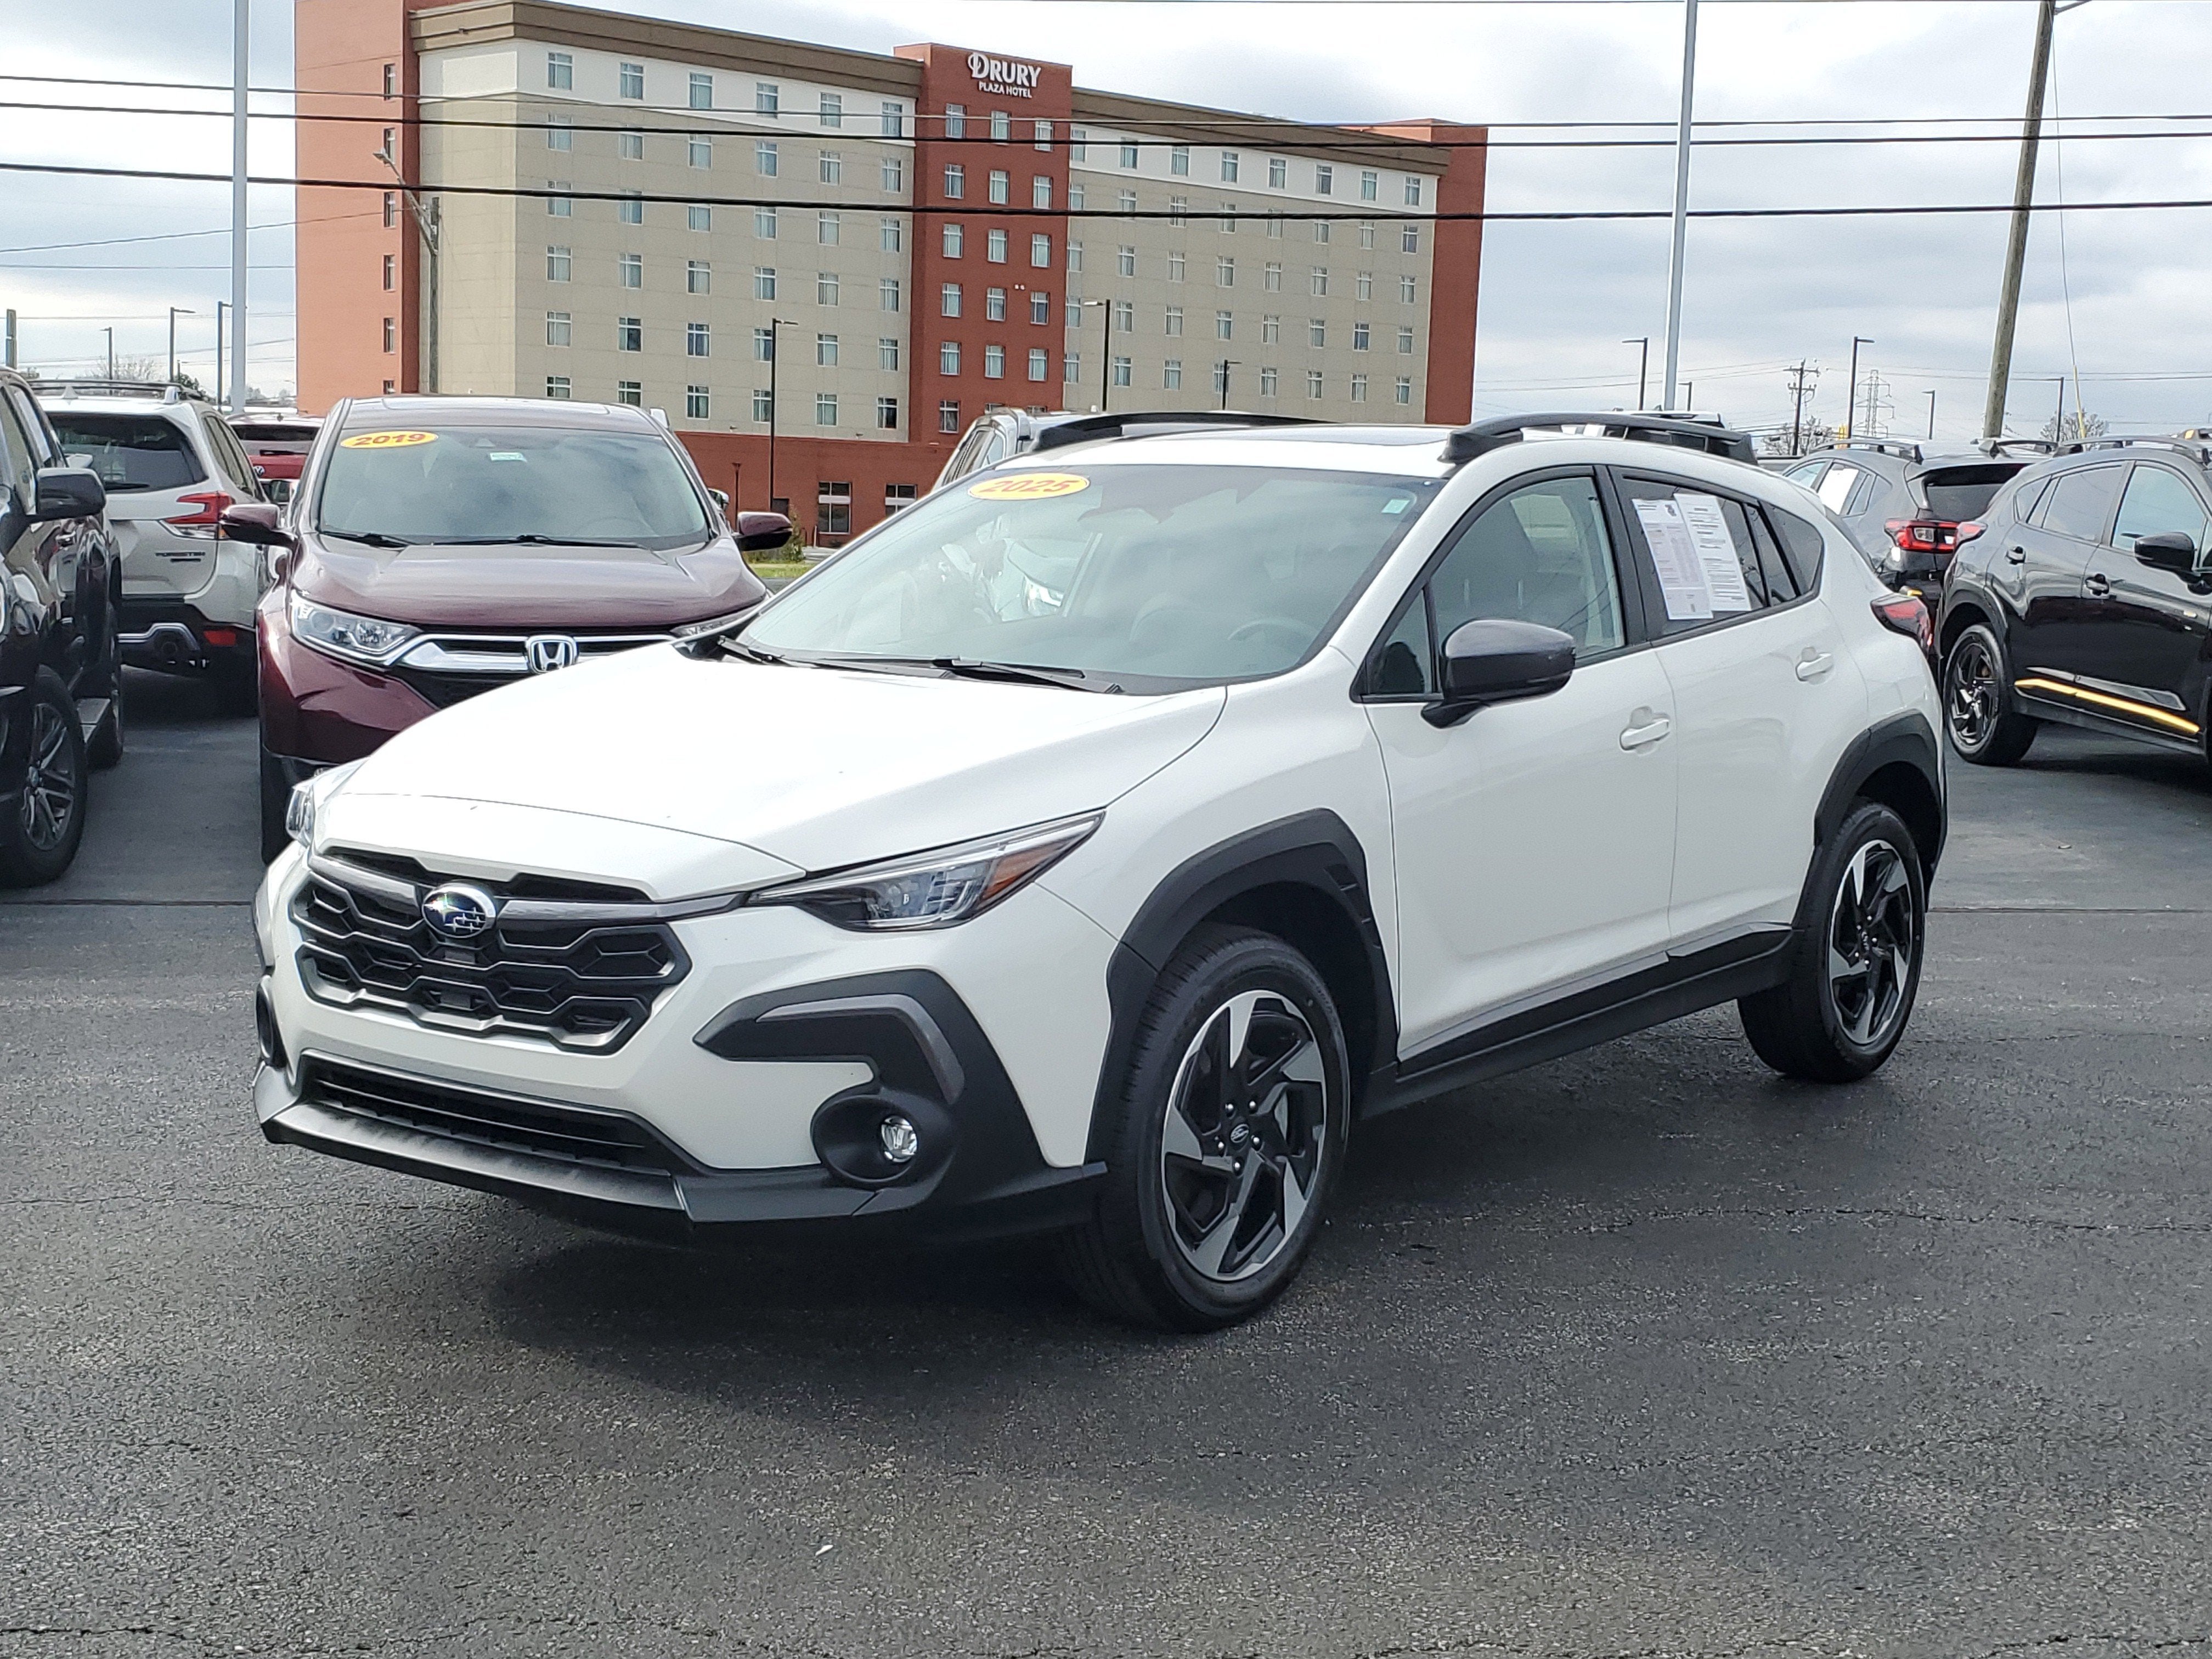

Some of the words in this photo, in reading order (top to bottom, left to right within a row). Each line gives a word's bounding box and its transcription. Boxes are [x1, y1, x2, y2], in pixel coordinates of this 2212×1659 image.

[968, 52, 1041, 87] DRURY
[979, 81, 1005, 94] PLAZA
[1006, 85, 1032, 98] HOTEL
[353, 433, 425, 445] 2019
[979, 480, 1080, 492] 2025
